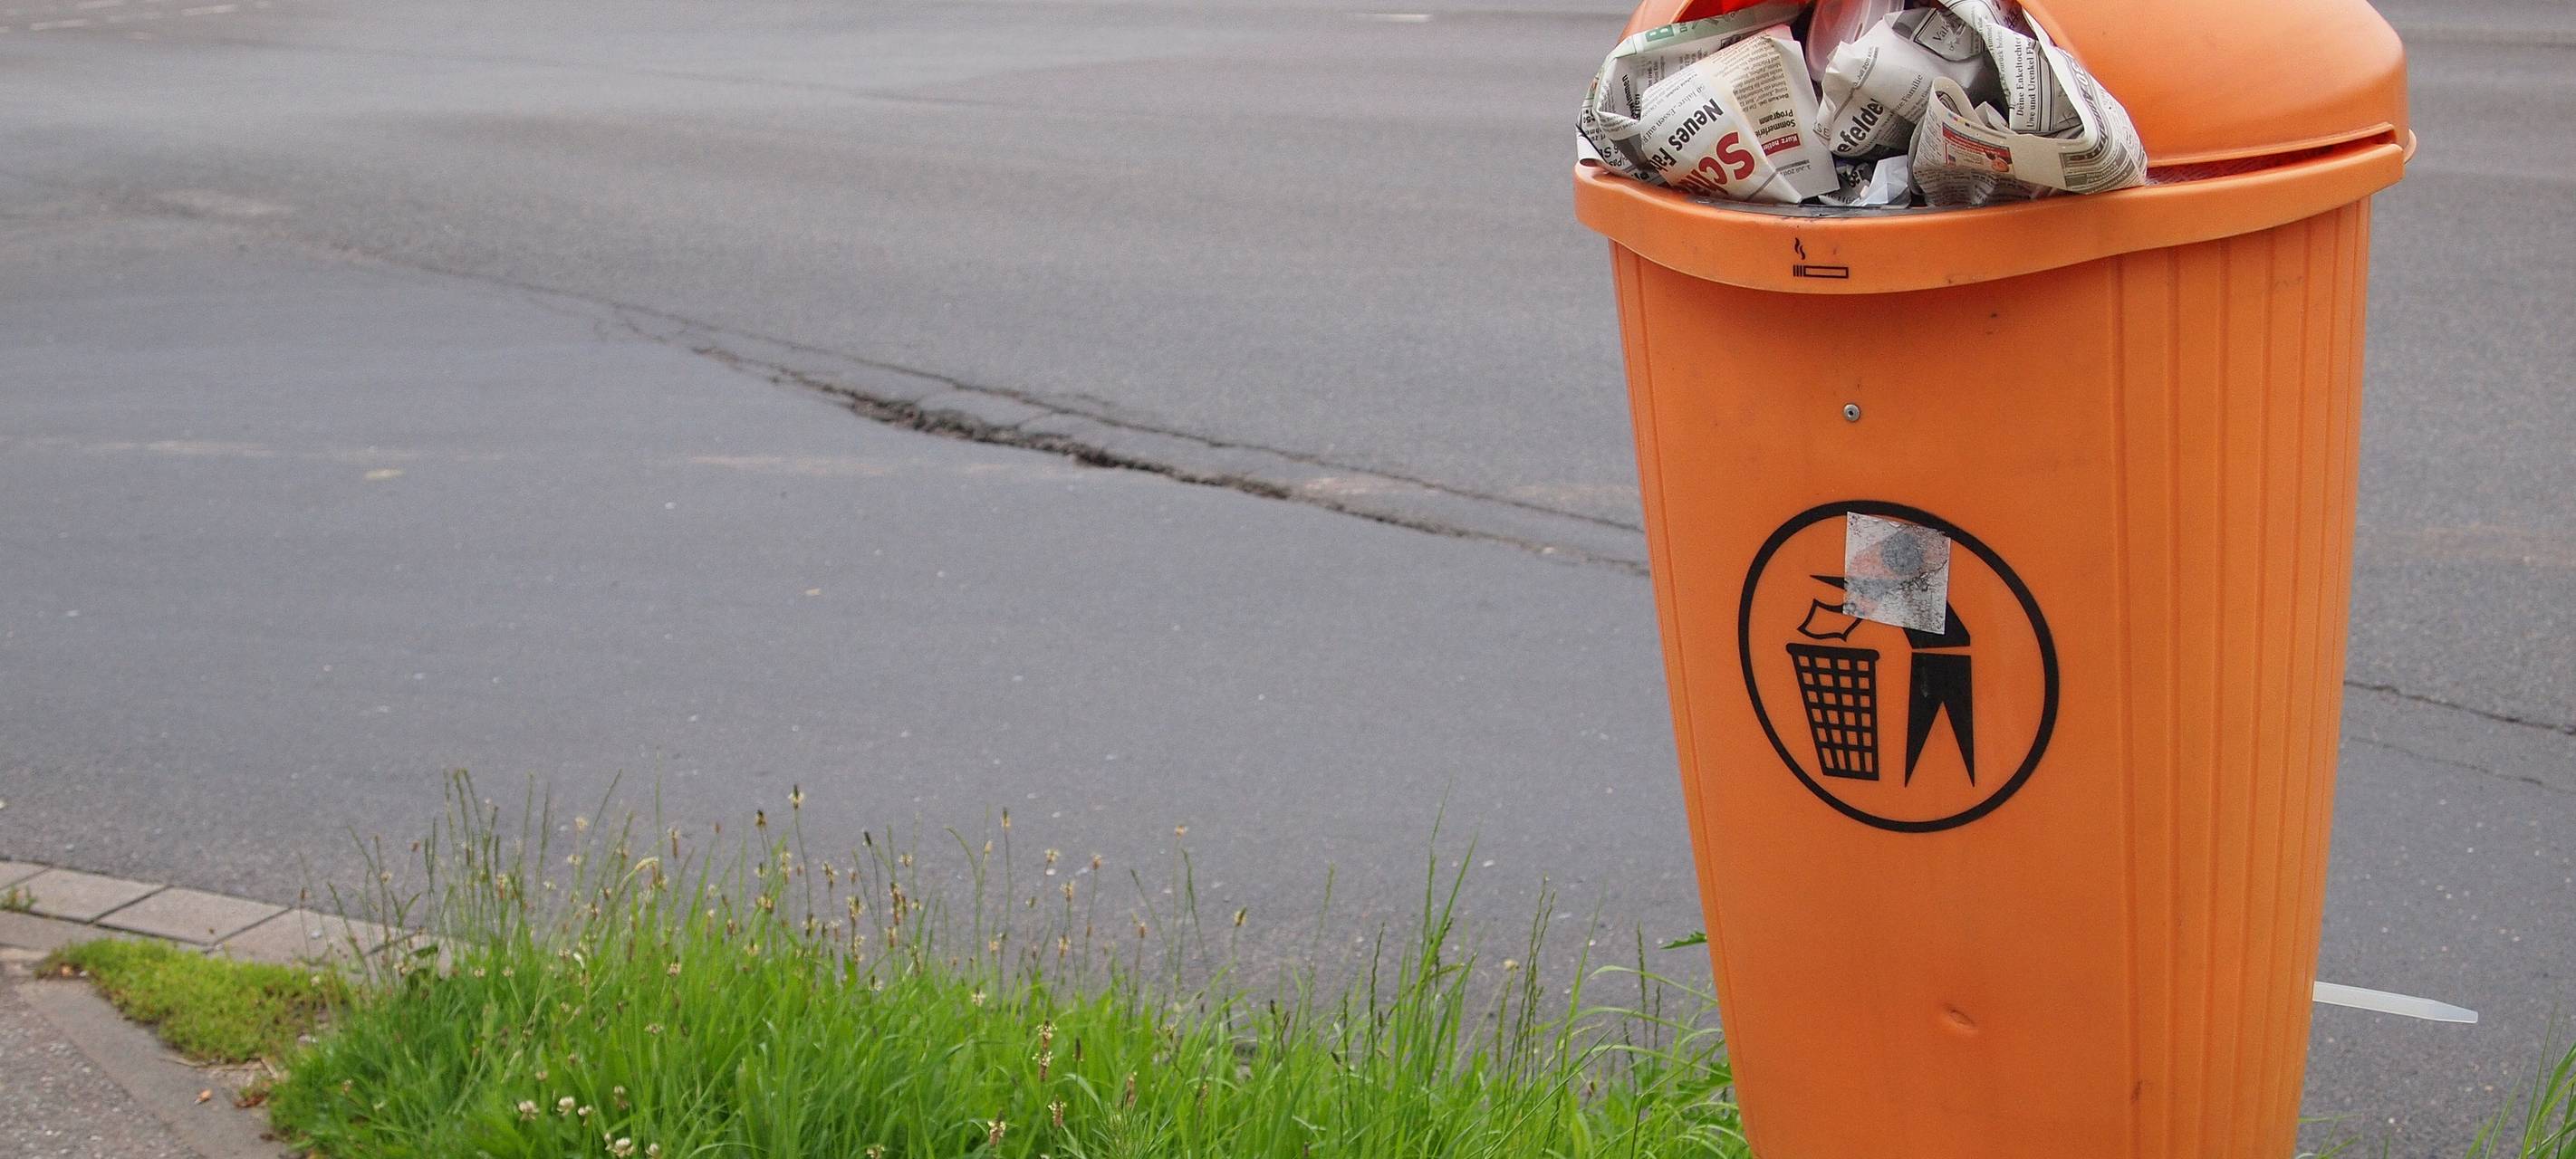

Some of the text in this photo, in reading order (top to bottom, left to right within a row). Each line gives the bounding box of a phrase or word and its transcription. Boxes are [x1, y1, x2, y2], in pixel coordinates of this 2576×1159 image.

[1902, 74, 1923, 107] Familie
[2016, 89, 2024, 116] Deine
[2028, 91, 2036, 110] und
[1668, 98, 1724, 151] Neues
[1759, 109, 1793, 125] Programm
[2027, 111, 2035, 128] Uwe
[1781, 134, 1798, 145] Kurz
